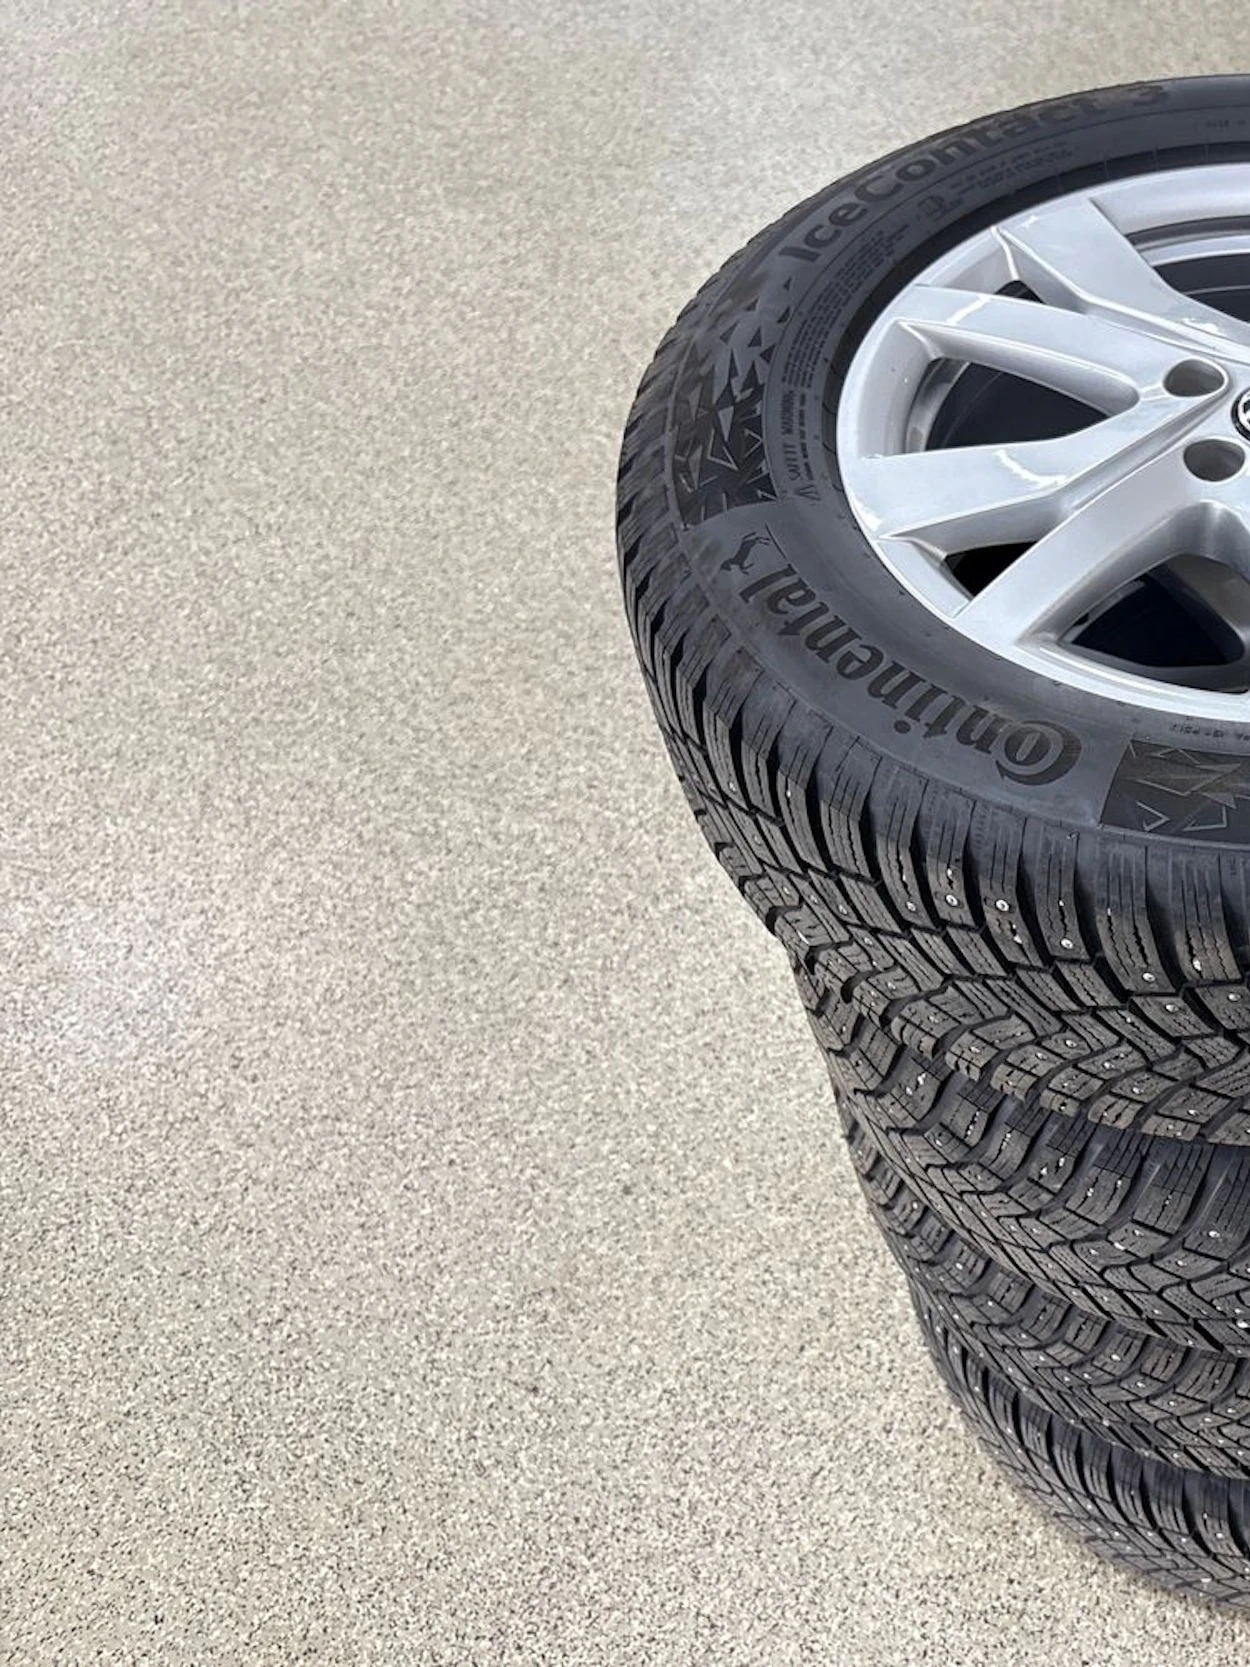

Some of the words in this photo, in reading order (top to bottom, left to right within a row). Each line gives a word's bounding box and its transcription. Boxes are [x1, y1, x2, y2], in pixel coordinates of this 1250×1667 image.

[778, 94, 1106, 264] IceContact
[1131, 83, 1171, 107] 3
[740, 563, 1082, 787] Continental
